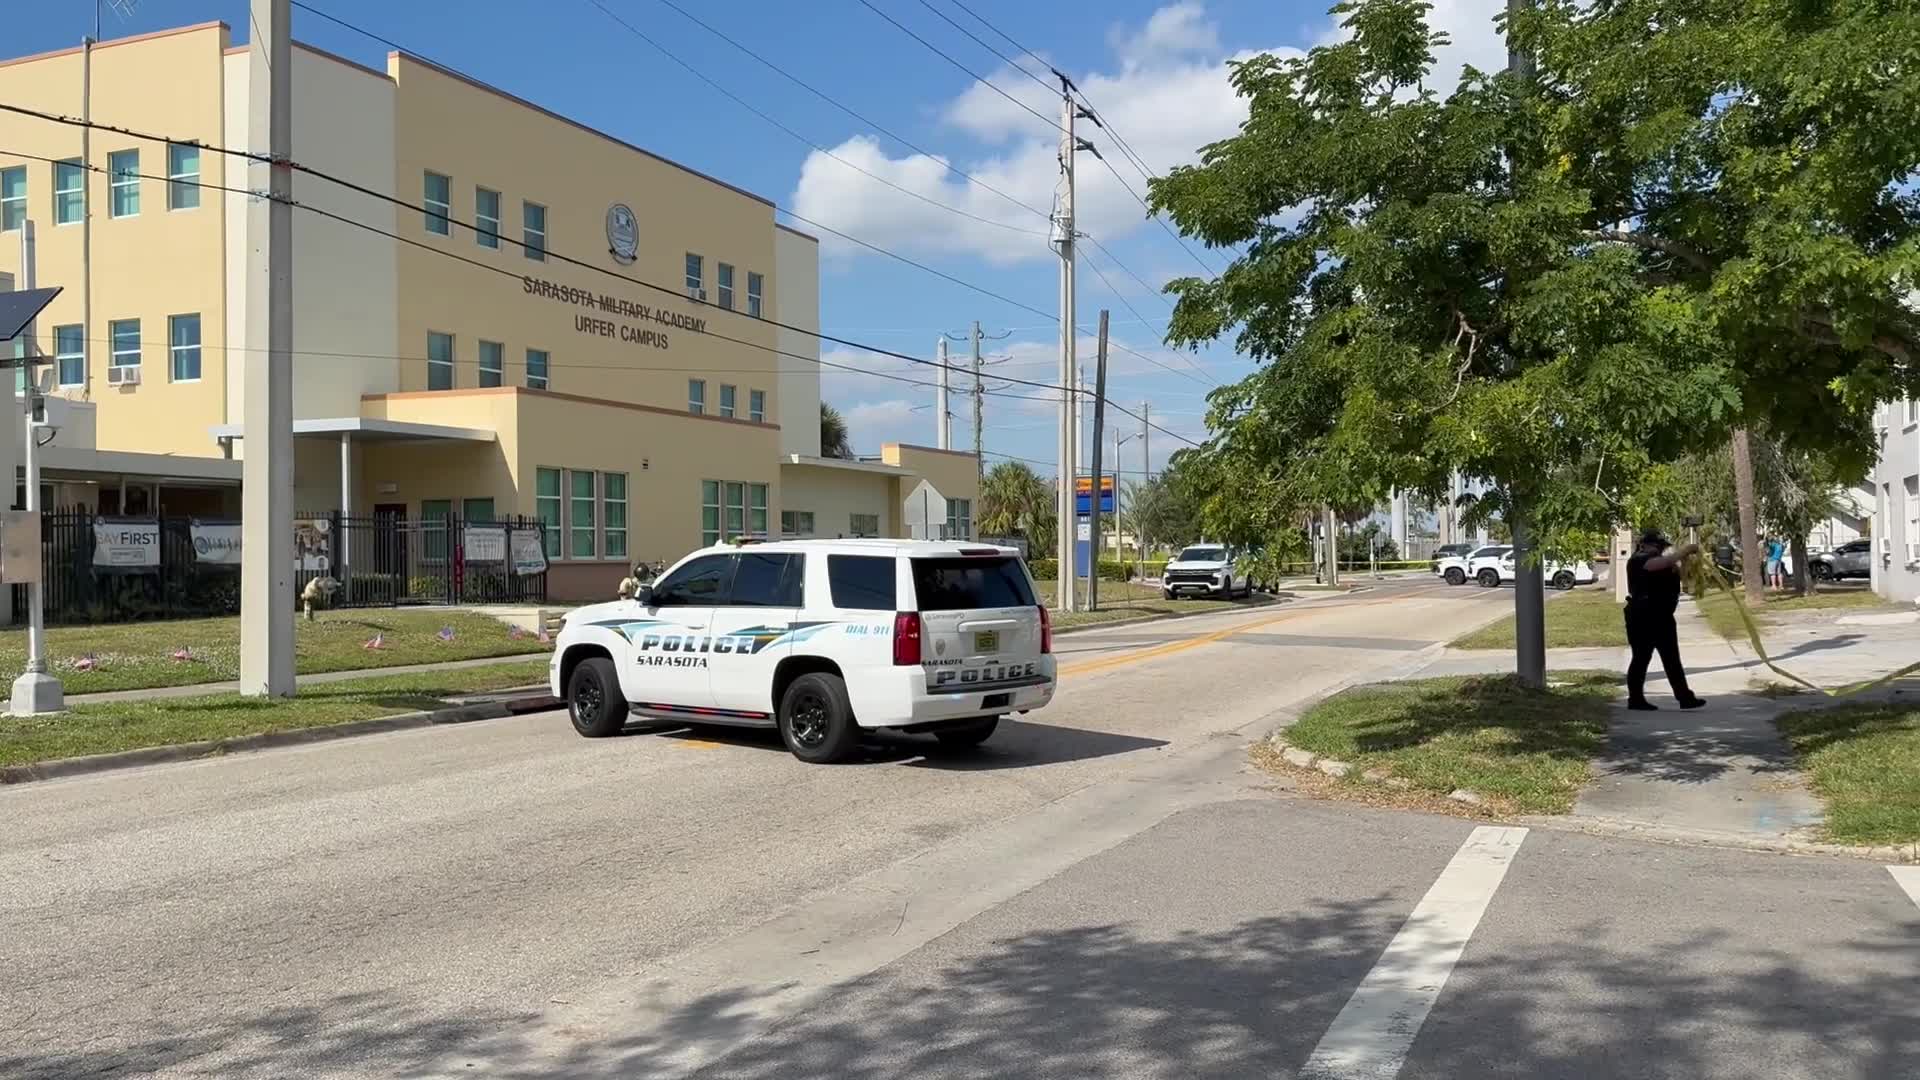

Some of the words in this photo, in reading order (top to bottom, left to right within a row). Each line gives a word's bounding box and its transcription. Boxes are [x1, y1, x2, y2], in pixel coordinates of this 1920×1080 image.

[523, 276, 595, 309] SARASOTA
[600, 294, 651, 321] MILITARY
[655, 309, 706, 334] ACADEMY
[575, 315, 615, 338] URFER
[620, 325, 669, 349] CAMPUS
[845, 624, 868, 635] DIAL
[873, 625, 890, 636] 911
[641, 635, 755, 655] POLICE
[636, 655, 708, 668] SARASOTA
[936, 662, 1035, 685] POLICE
